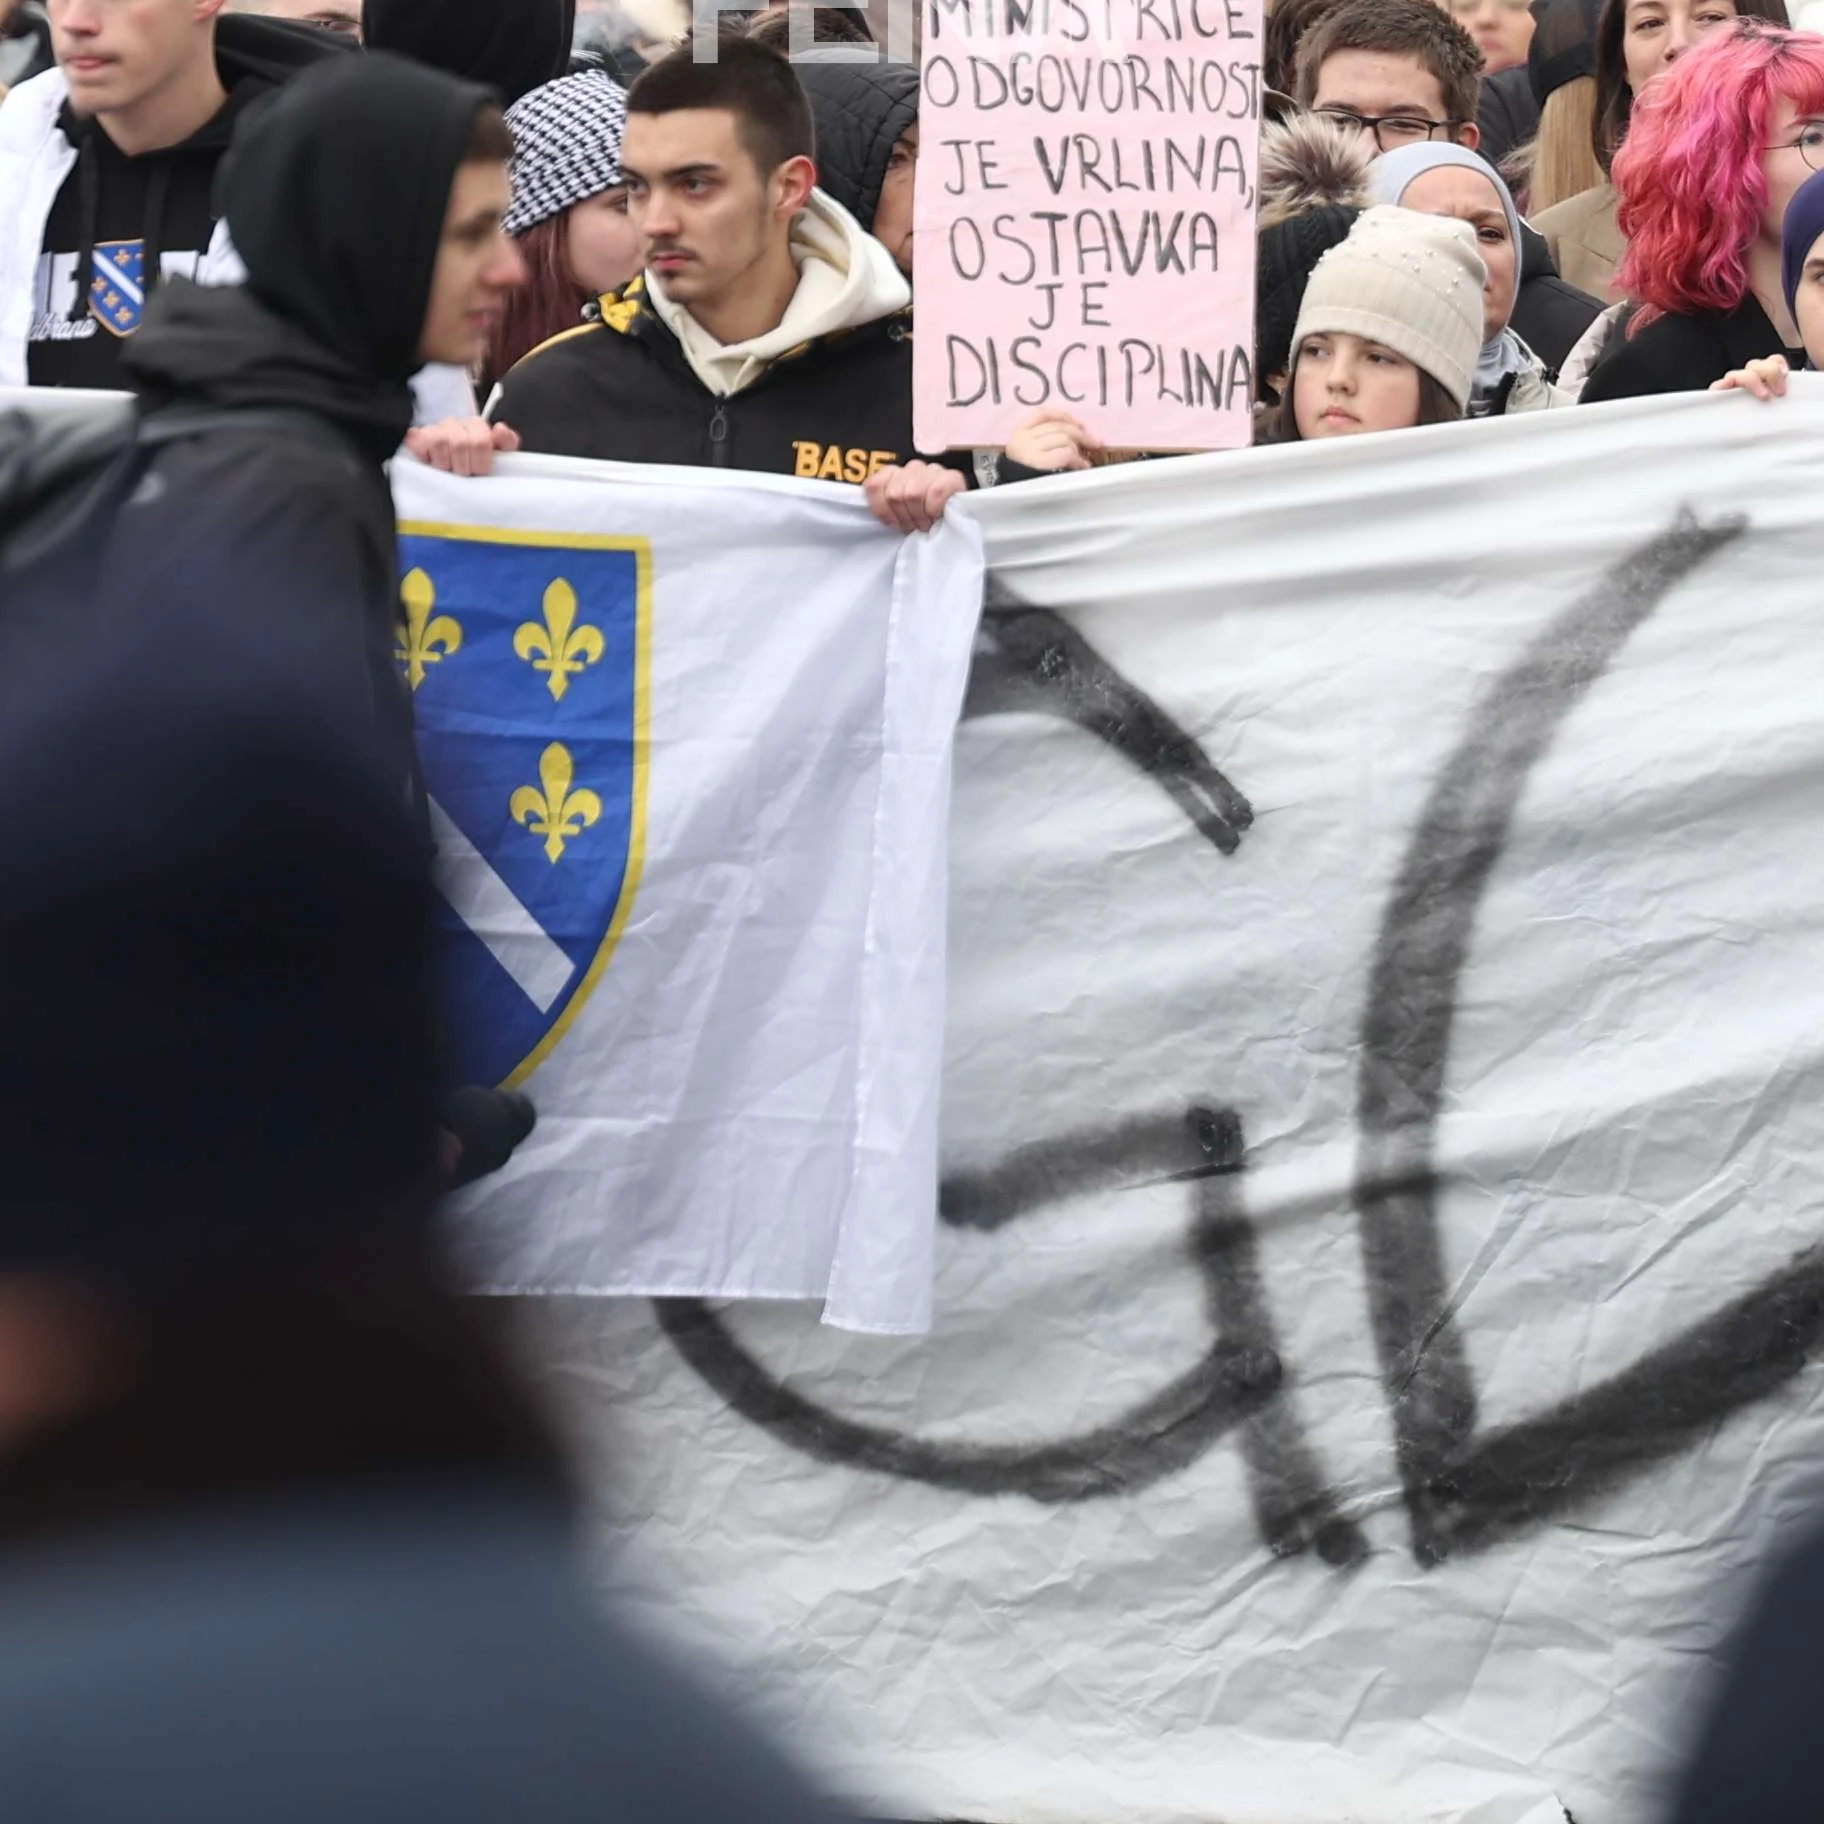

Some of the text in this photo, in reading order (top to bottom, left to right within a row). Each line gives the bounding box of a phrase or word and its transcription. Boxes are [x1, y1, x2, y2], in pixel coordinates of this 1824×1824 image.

[923, 51, 1264, 120] ODGOVORNOST
[939, 134, 1256, 210] JE VRLINA,
[948, 208, 1219, 286] OSTAVKA
[1027, 280, 1112, 331] JE
[945, 333, 1254, 414] DISCIPLINA
